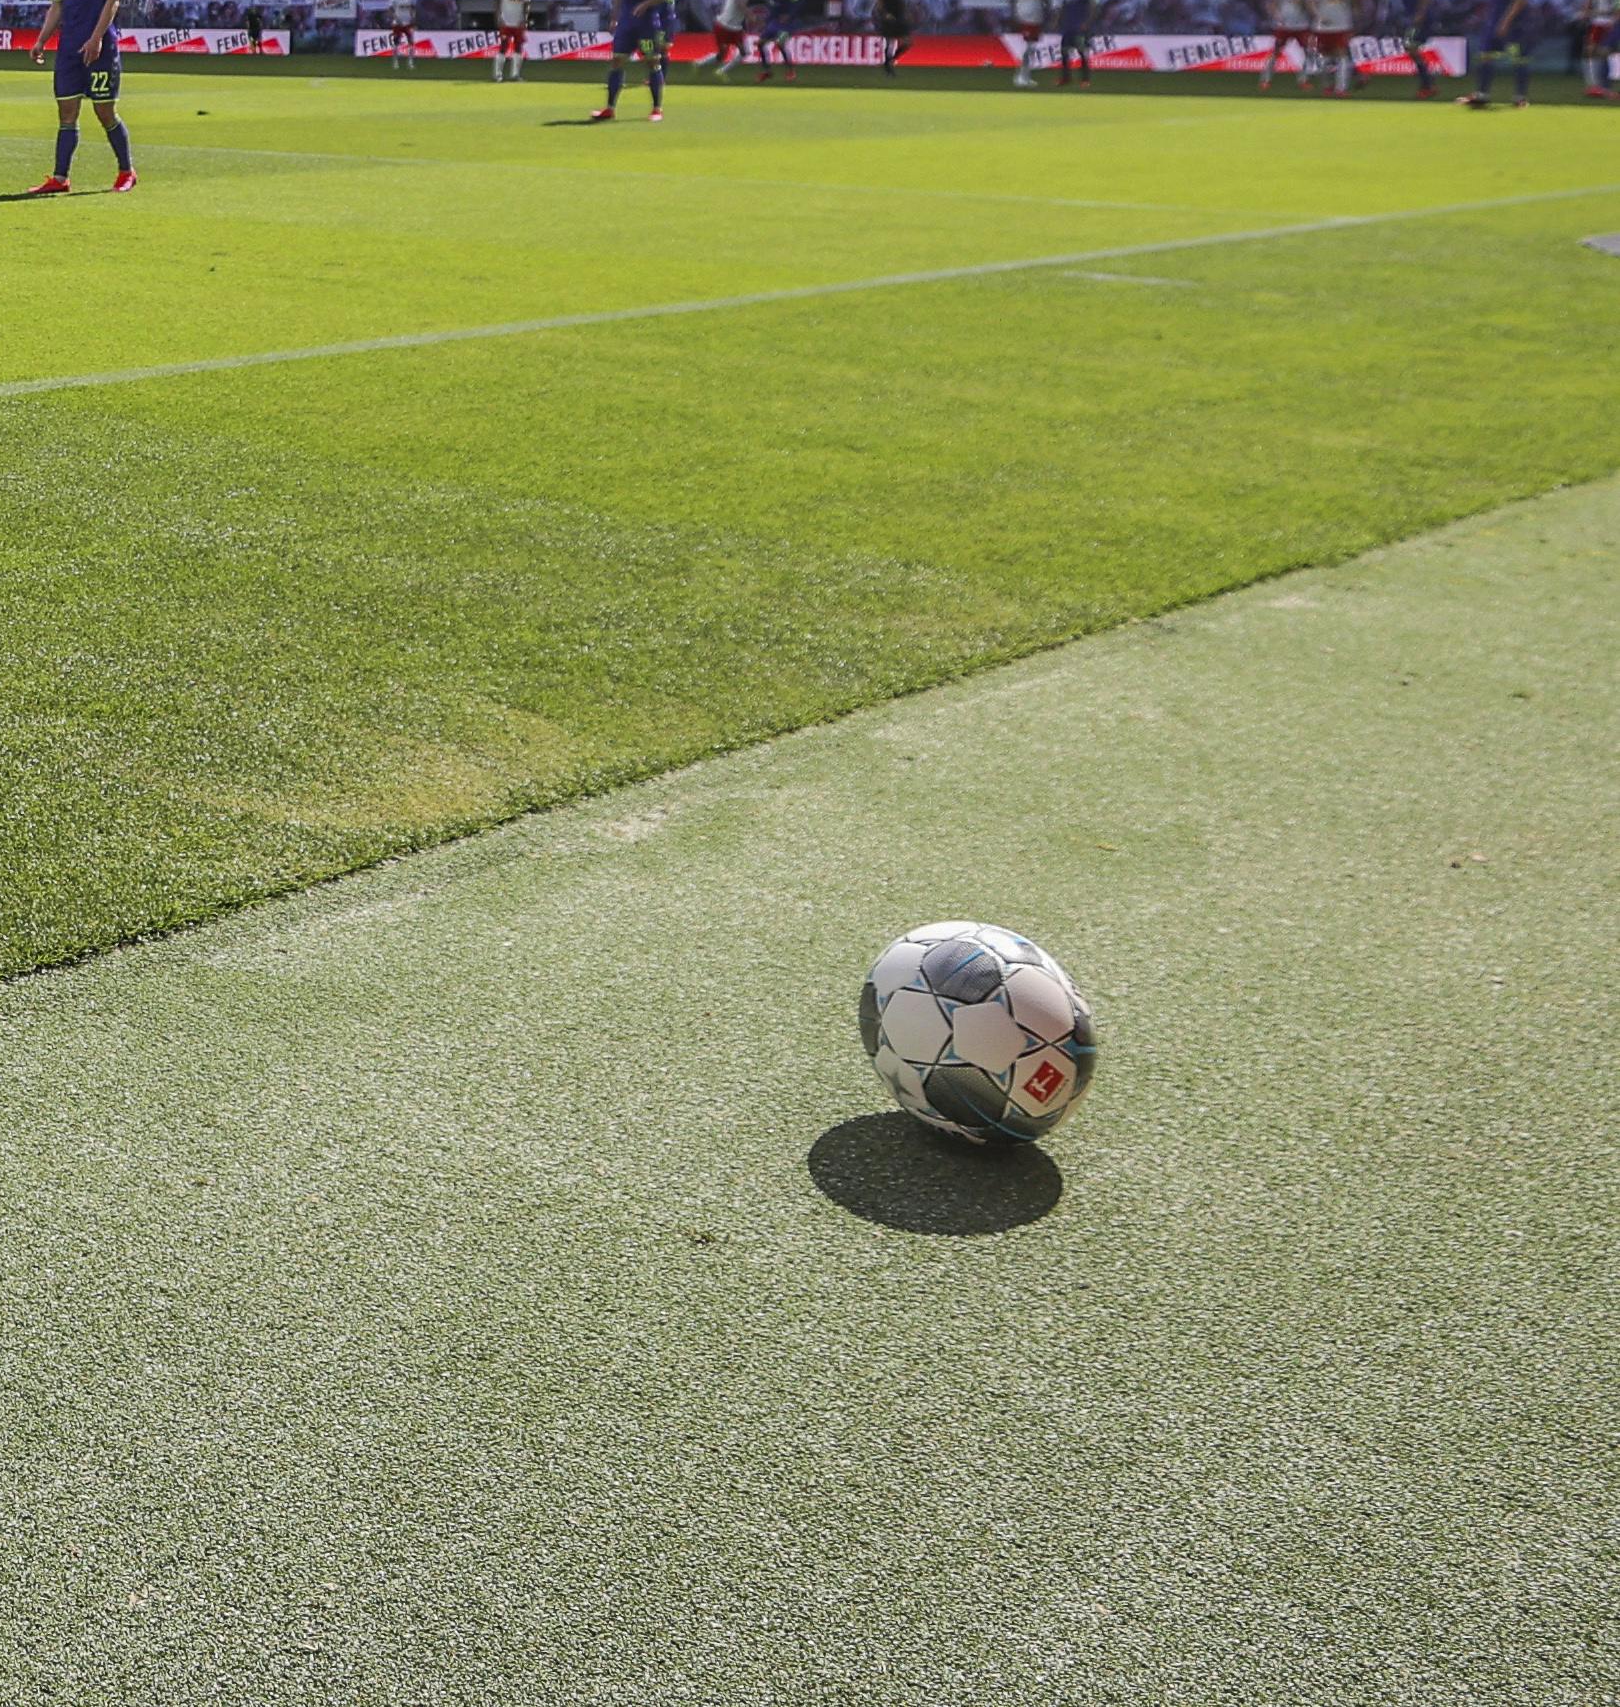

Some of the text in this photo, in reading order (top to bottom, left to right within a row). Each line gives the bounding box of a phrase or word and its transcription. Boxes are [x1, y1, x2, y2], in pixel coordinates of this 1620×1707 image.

[146, 29, 191, 51] FENGER
[216, 32, 248, 53] FENG
[449, 31, 502, 55] FENGER
[539, 32, 599, 56] FENGER
[1168, 36, 1257, 66] FENGER
[91, 72, 109, 92] 22
